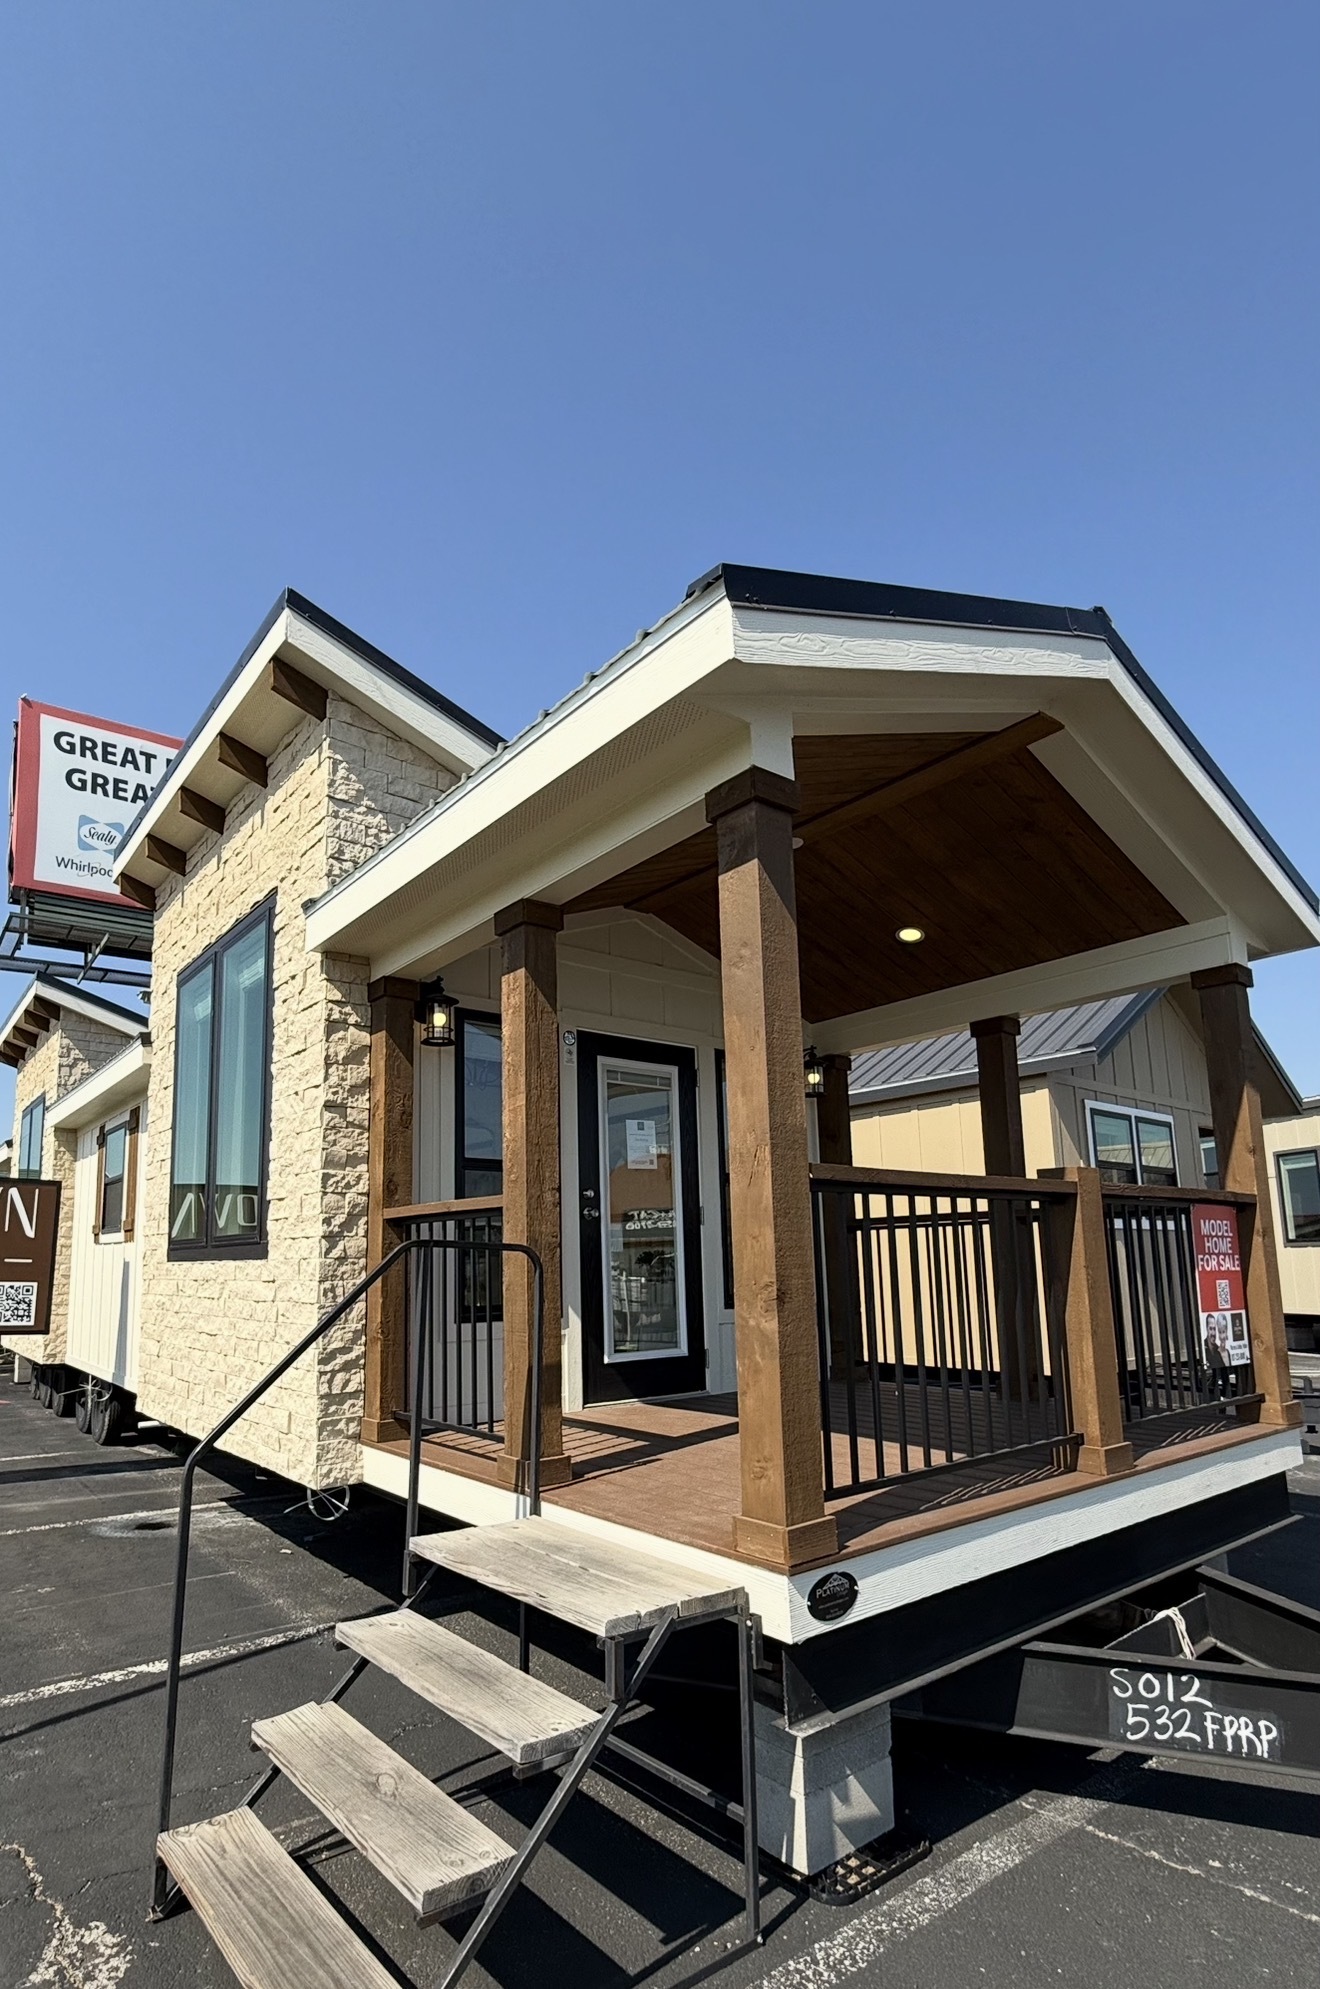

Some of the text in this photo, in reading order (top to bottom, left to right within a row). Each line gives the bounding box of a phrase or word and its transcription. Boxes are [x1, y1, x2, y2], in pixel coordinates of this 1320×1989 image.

[53, 730, 157, 775] GREAT
[65, 767, 155, 804] GREA
[83, 826, 117, 845] Sealy
[1200, 1219, 1233, 1236] MODEL
[1204, 1237, 1232, 1254] HOME
[1198, 1255, 1240, 1272] FOR SALE
